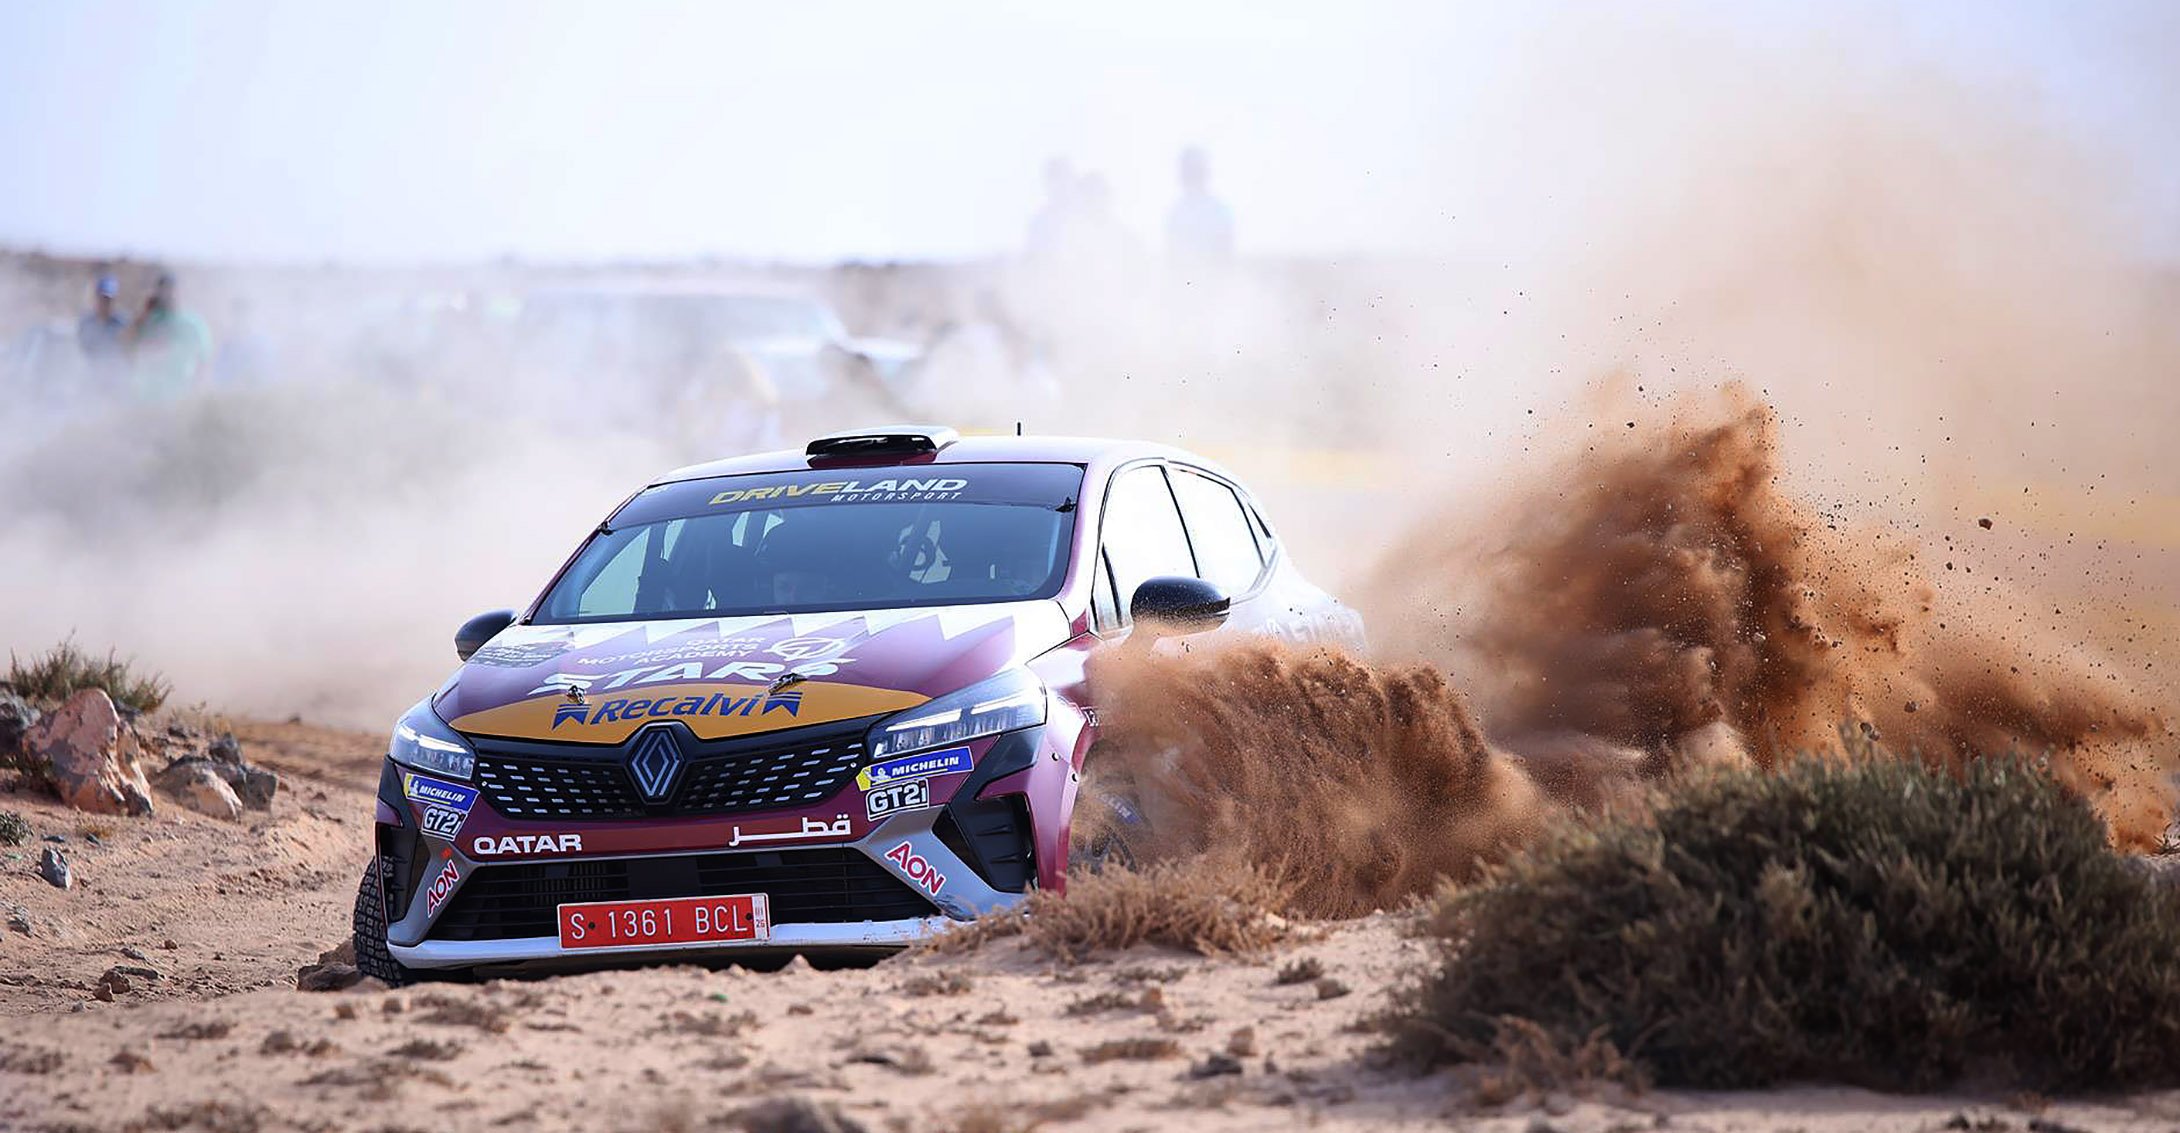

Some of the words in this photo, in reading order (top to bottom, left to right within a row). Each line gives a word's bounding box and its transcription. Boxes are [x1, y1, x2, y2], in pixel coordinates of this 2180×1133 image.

[709, 478, 968, 505] DRIVELAND
[830, 491, 963, 503] MOTORSPORT
[633, 650, 755, 666] ACADEMY
[526, 657, 857, 696] STARS
[590, 692, 765, 726] Recalvi
[892, 756, 960, 777] MICHELIN
[419, 785, 467, 803] MICHELIN
[473, 833, 583, 855] QATAR
[728, 813, 851, 847] قطر
[887, 841, 945, 895] AON
[426, 859, 460, 918] AON
[570, 912, 586, 940] S
[608, 908, 673, 939] 1361
[695, 904, 748, 934] BCL
